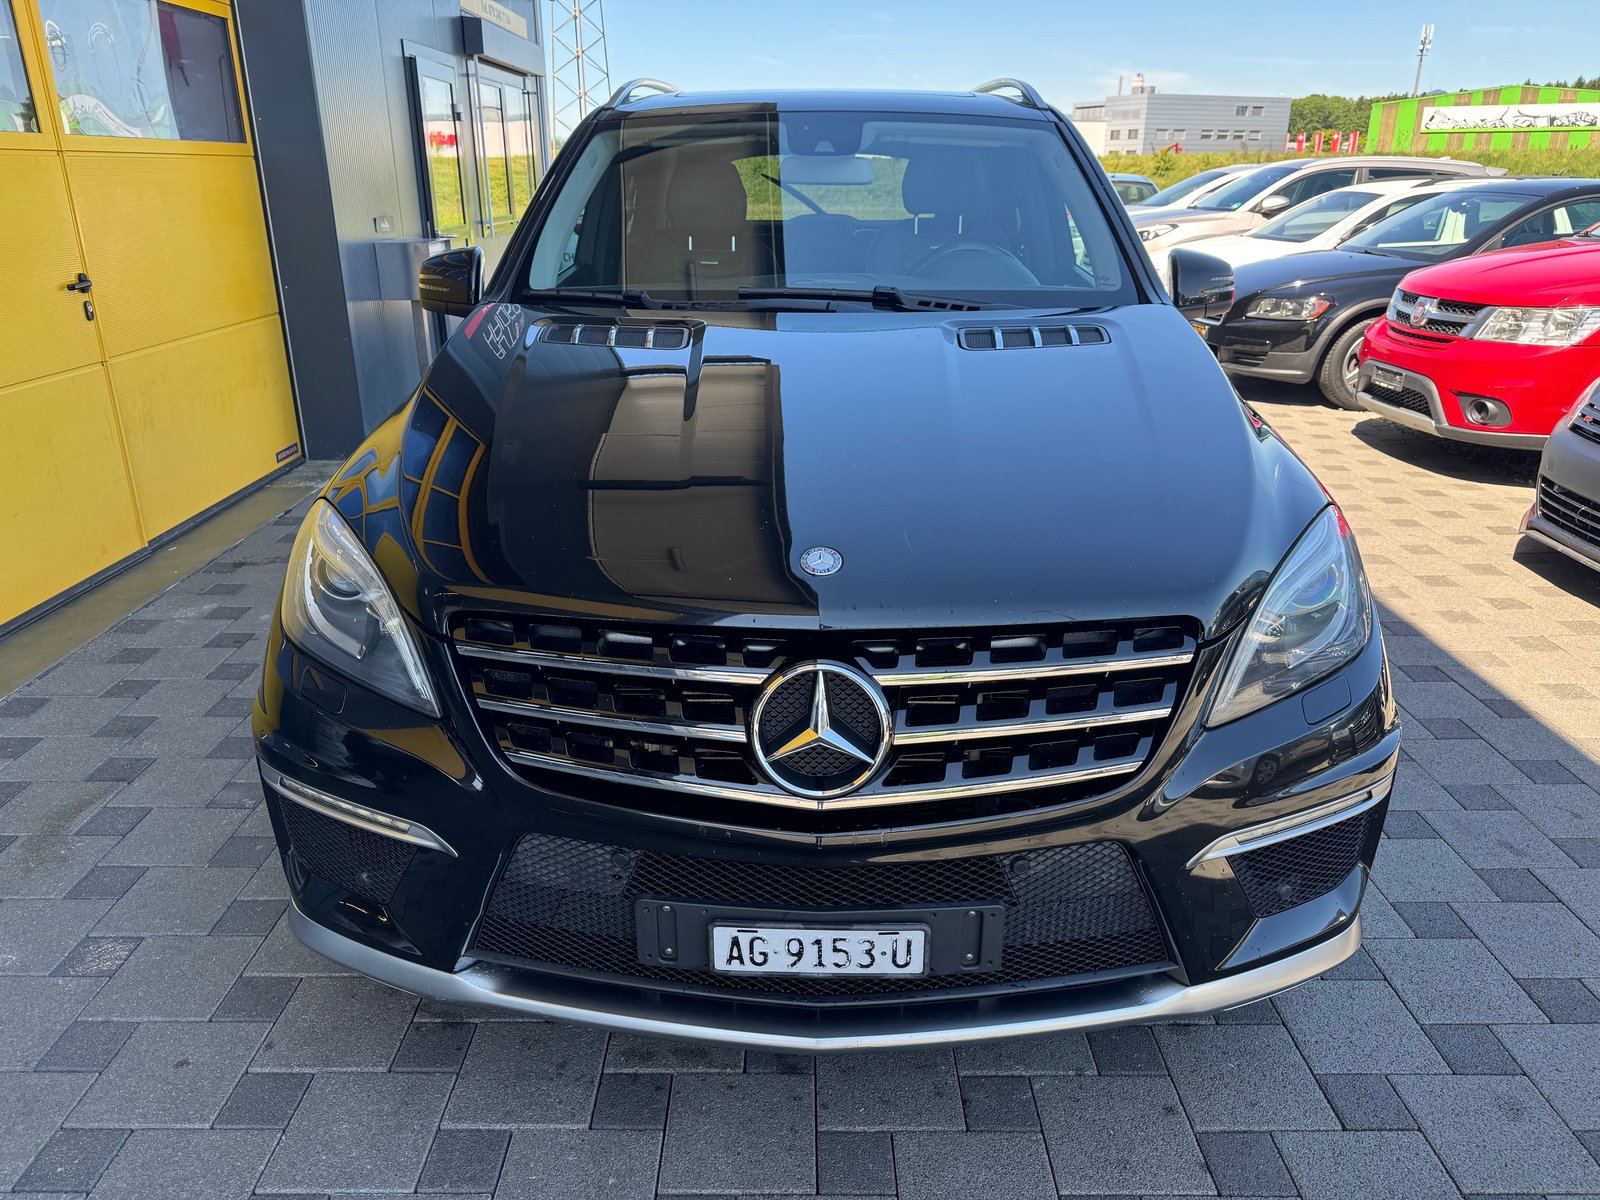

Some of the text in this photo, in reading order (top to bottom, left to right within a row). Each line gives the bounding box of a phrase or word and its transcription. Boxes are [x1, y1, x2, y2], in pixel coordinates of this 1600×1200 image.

[726, 935, 914, 969] AG 9153 U
